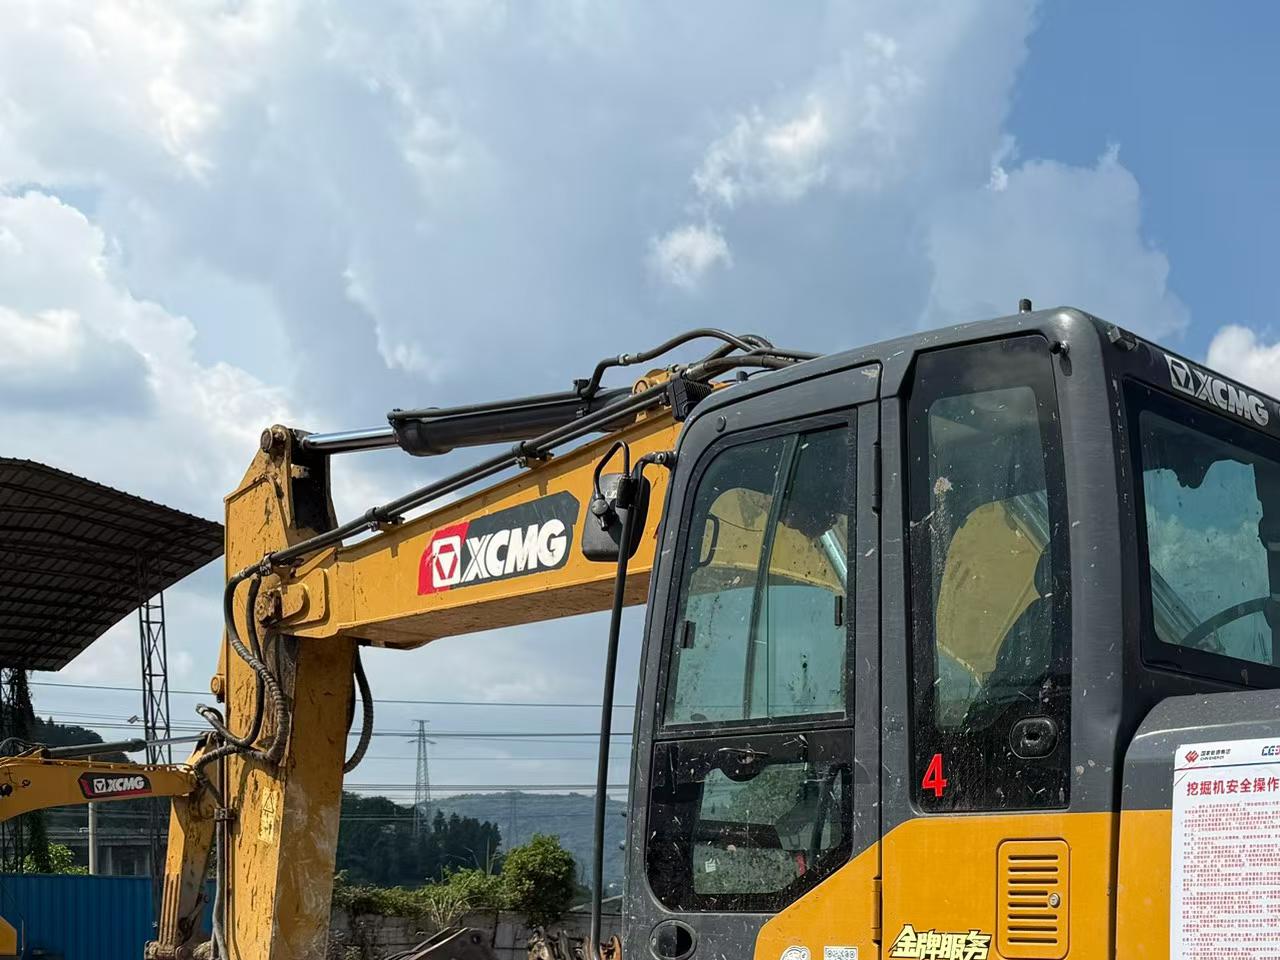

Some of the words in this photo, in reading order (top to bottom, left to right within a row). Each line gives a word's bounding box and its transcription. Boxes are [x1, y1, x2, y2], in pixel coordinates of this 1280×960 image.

[1193, 368, 1269, 427] XCMG
[460, 518, 567, 583] XCMG
[106, 776, 145, 793] XCMG
[922, 753, 948, 797] 4
